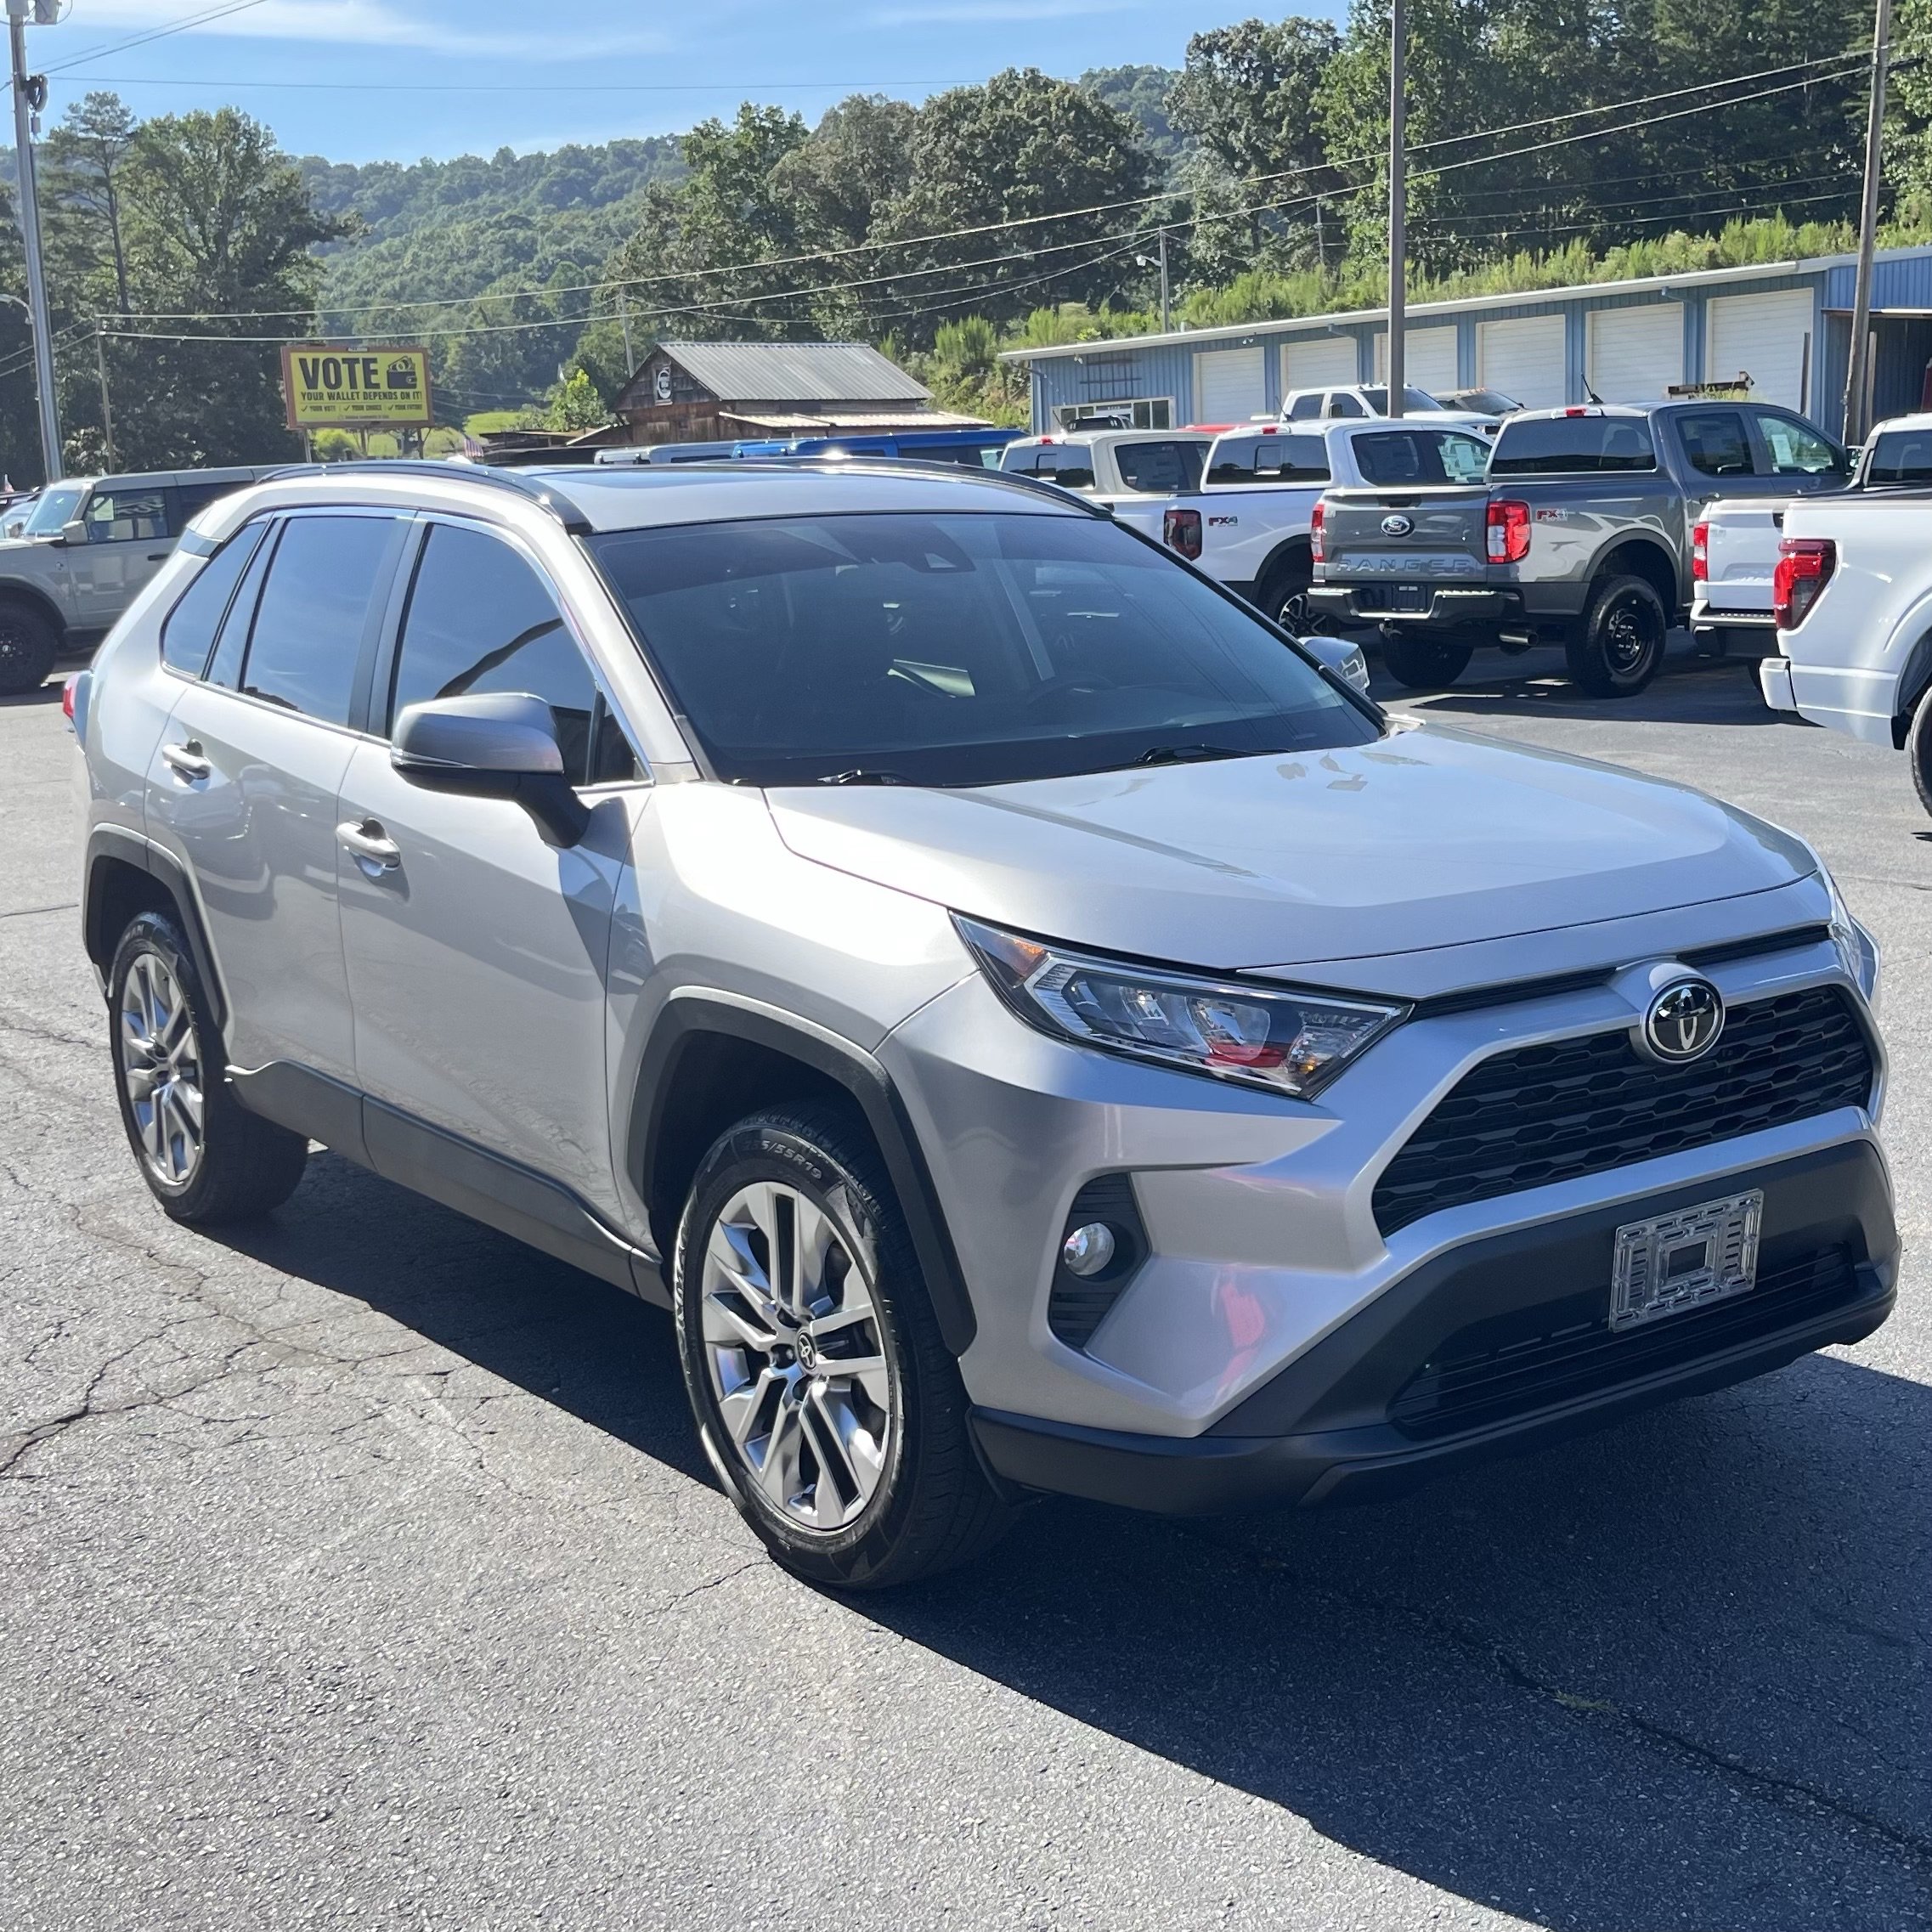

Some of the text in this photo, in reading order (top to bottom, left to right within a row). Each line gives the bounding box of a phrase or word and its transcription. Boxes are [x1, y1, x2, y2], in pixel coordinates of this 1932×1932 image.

[299, 357, 381, 390] VOTE
[301, 392, 324, 401] YOUR
[327, 392, 359, 401] WALLET
[364, 391, 398, 400] DEPENDS
[400, 391, 411, 400] ON
[1208, 517, 1238, 527] FX4
[1336, 558, 1471, 572] RANGER
